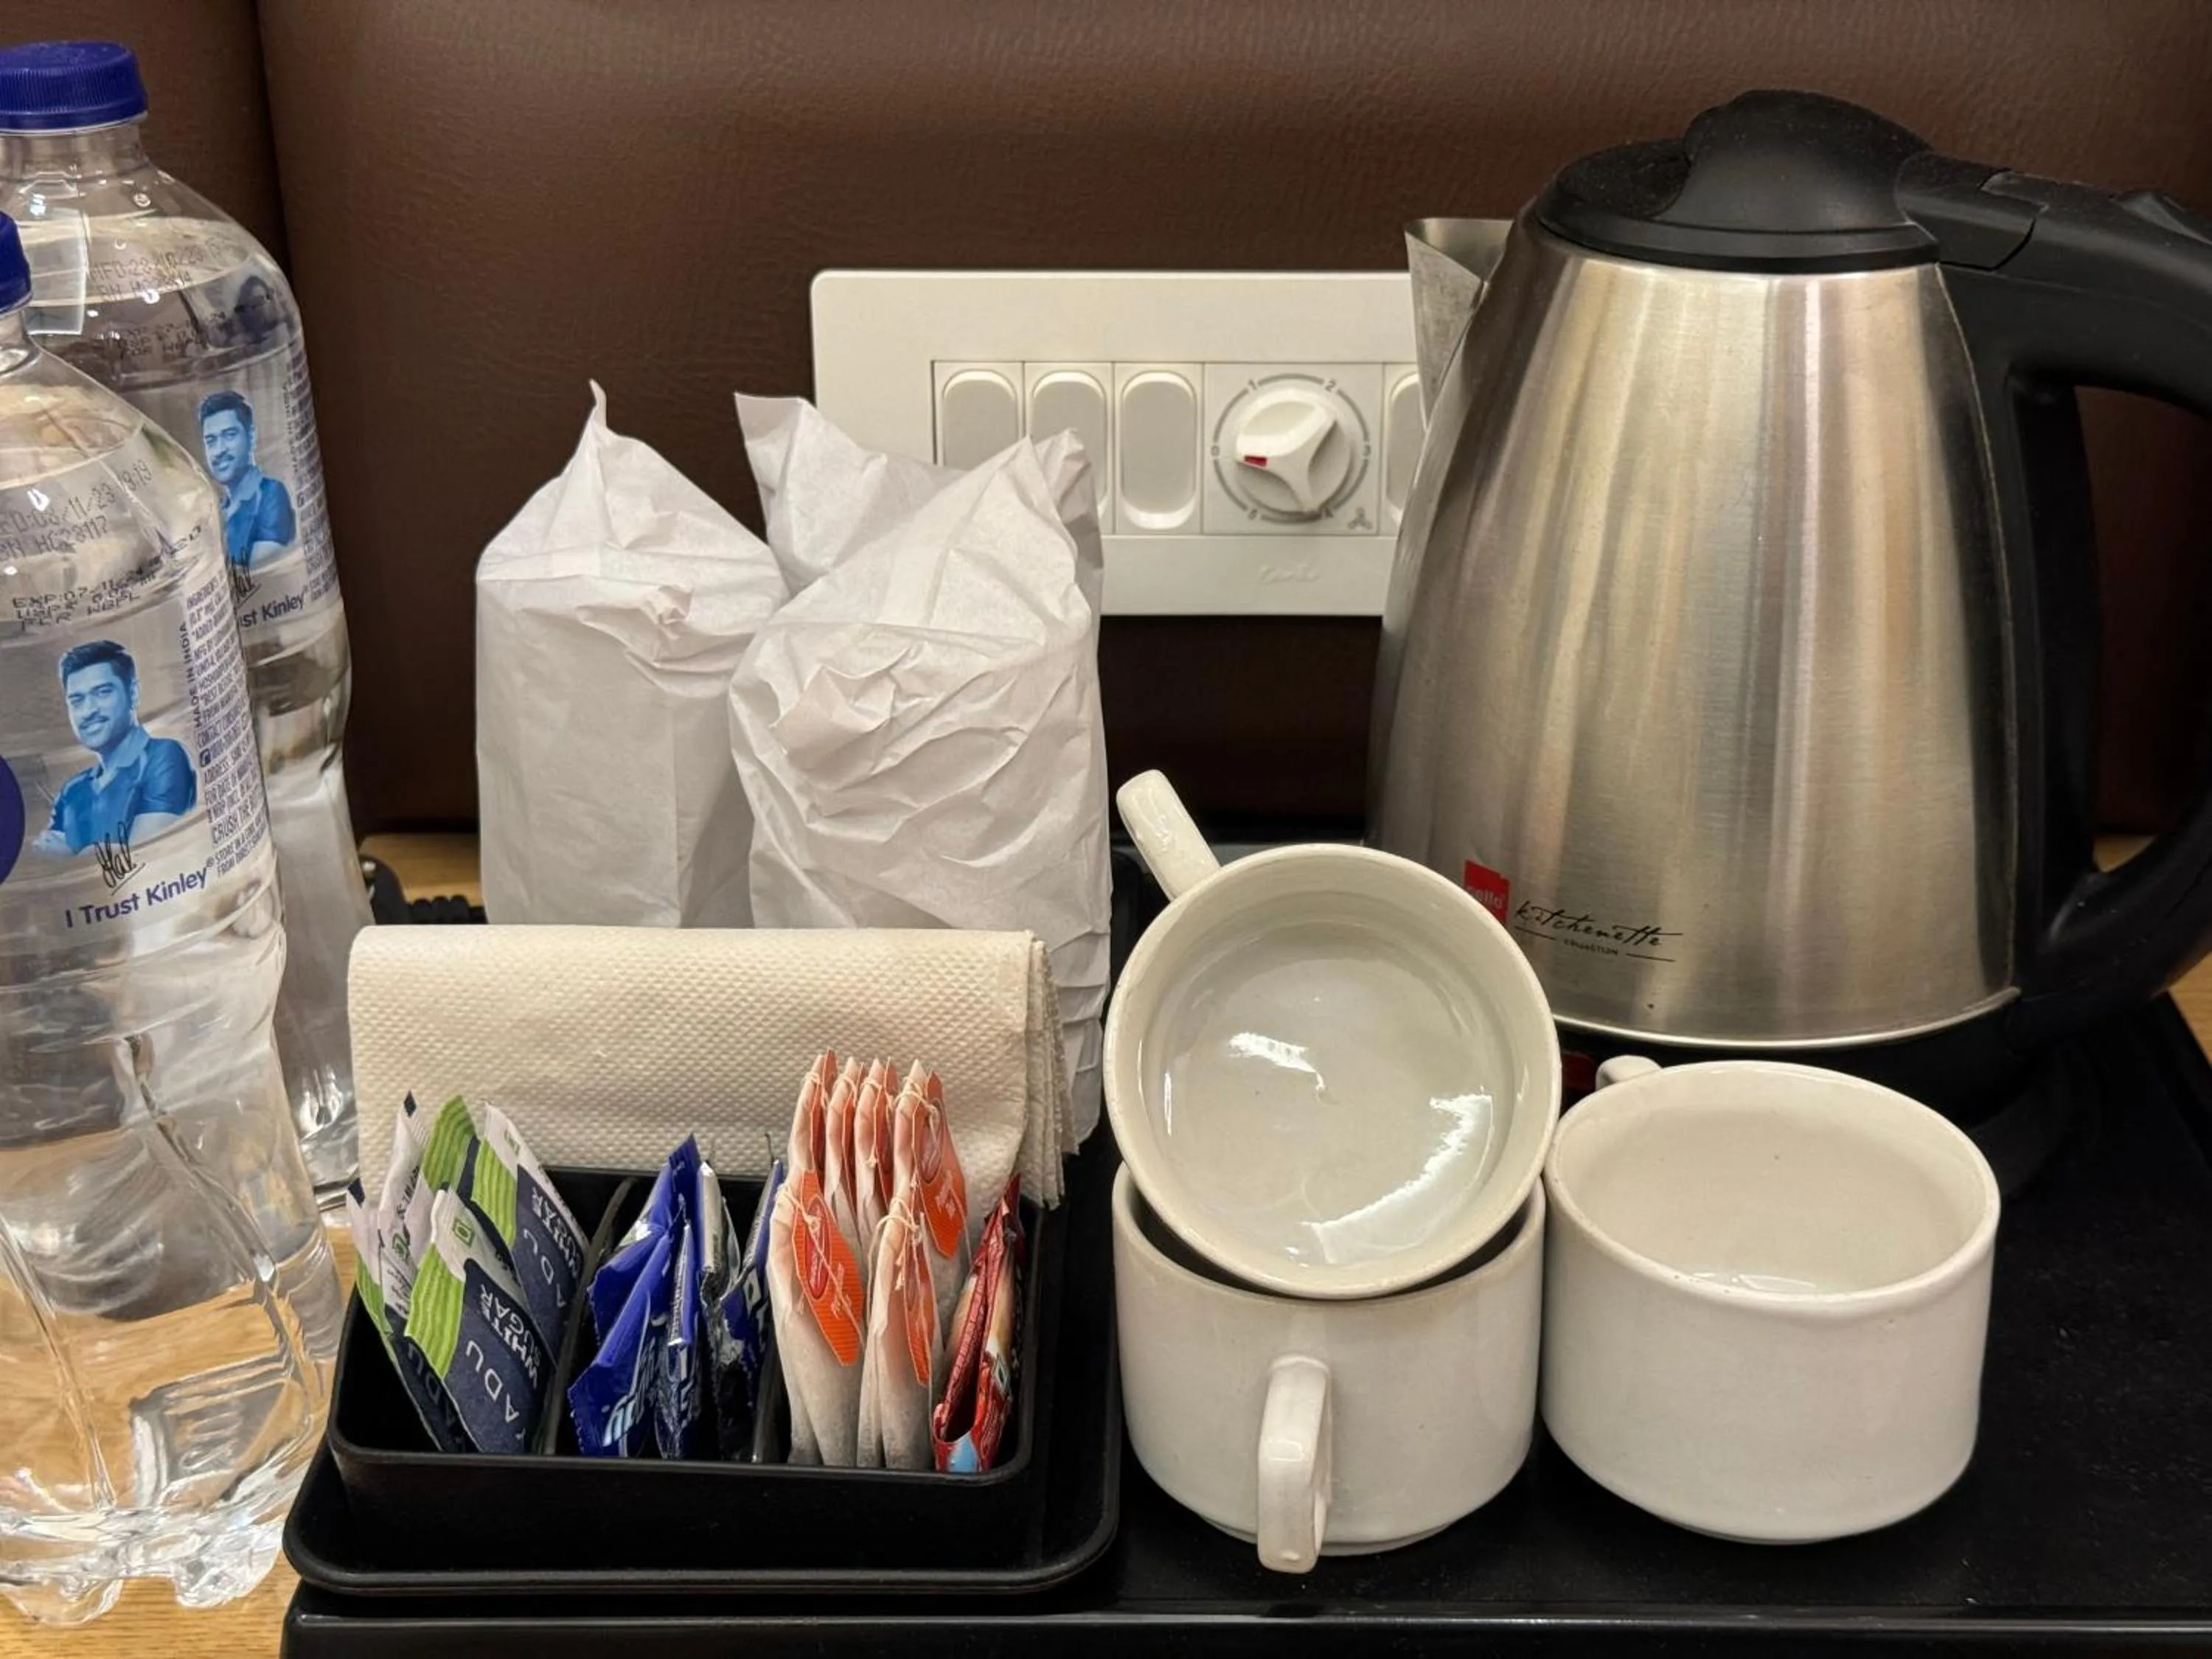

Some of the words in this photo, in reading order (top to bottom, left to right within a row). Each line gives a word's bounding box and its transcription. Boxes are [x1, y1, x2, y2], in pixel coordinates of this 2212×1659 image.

[1248, 379, 1257, 390] 1
[1325, 378, 1336, 393] 2
[1364, 443, 1371, 456] 3
[65, 908, 73, 929] I
[79, 893, 140, 924] Trust
[481, 1284, 541, 1366] SUGAR
[480, 1295, 539, 1390] WHITE
